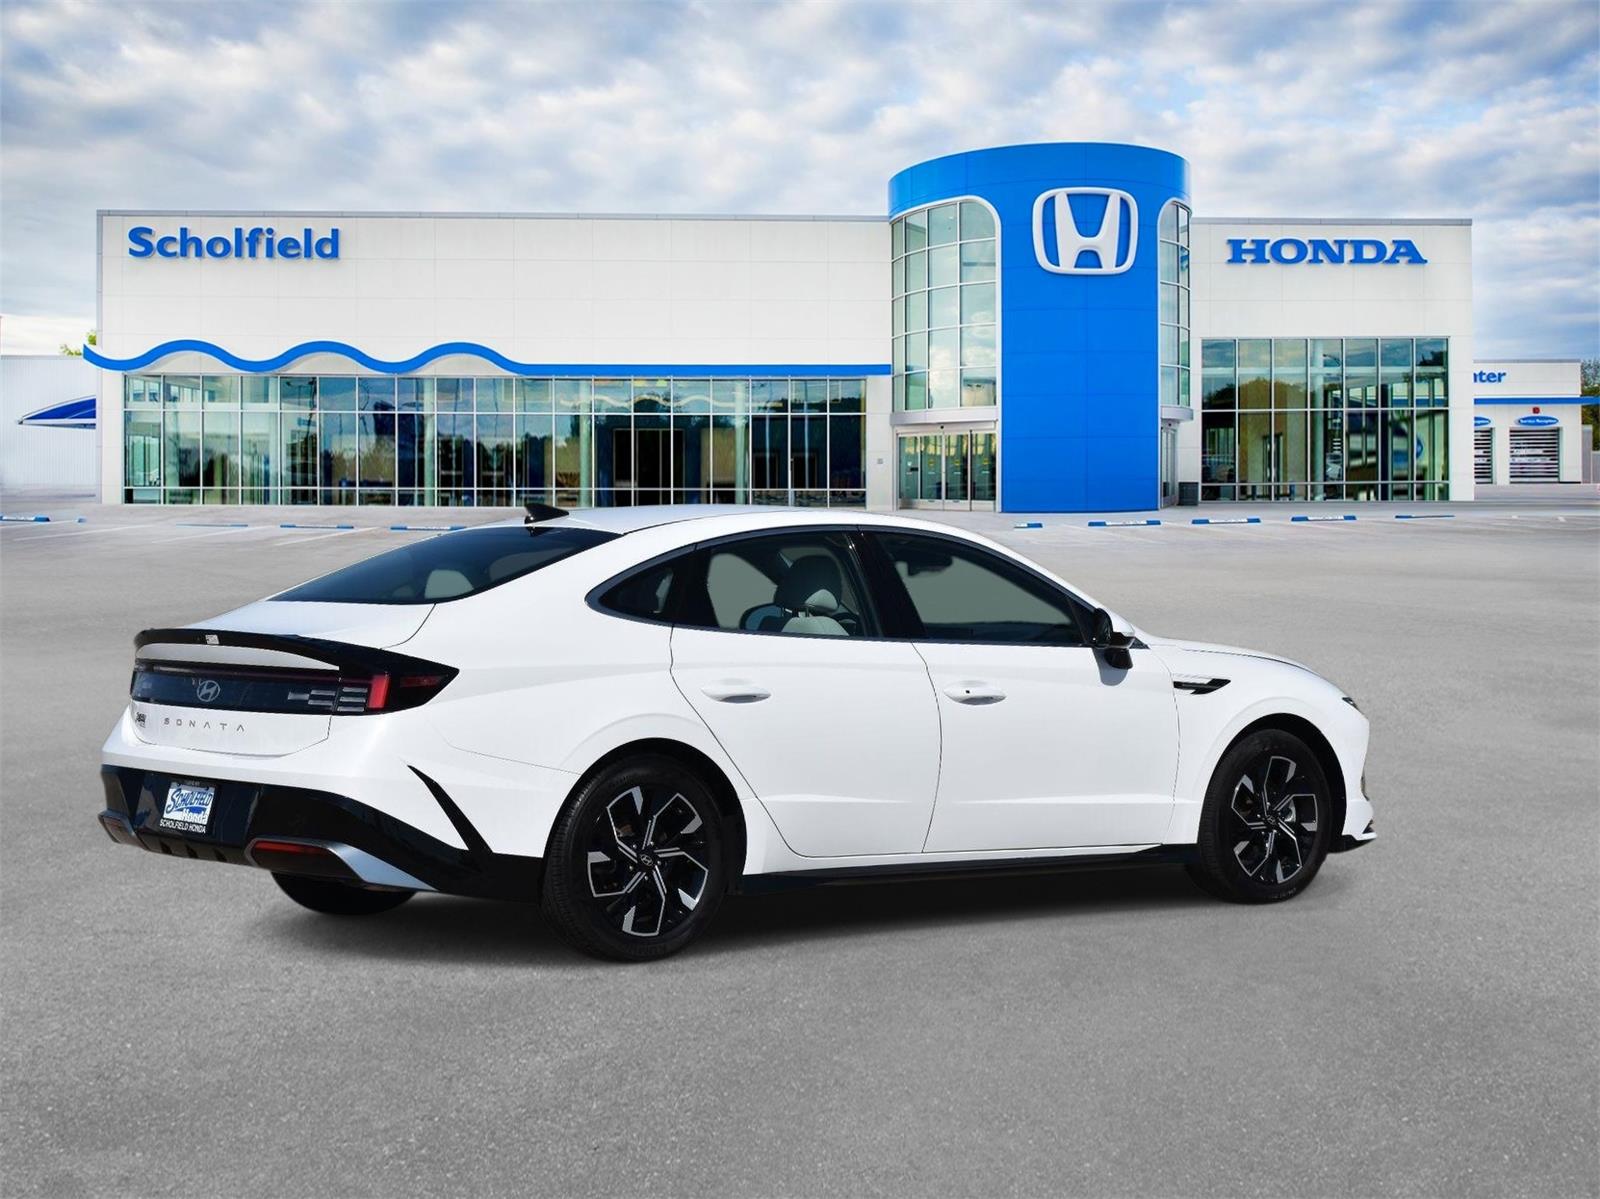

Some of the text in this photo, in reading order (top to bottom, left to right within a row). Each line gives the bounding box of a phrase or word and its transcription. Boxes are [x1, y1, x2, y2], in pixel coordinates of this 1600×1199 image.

[128, 226, 340, 259] Scholfield
[1226, 238, 1428, 265] HONDA
[164, 717, 246, 732] SONATA
[159, 819, 206, 834] SCHOLFIELD HONDA
